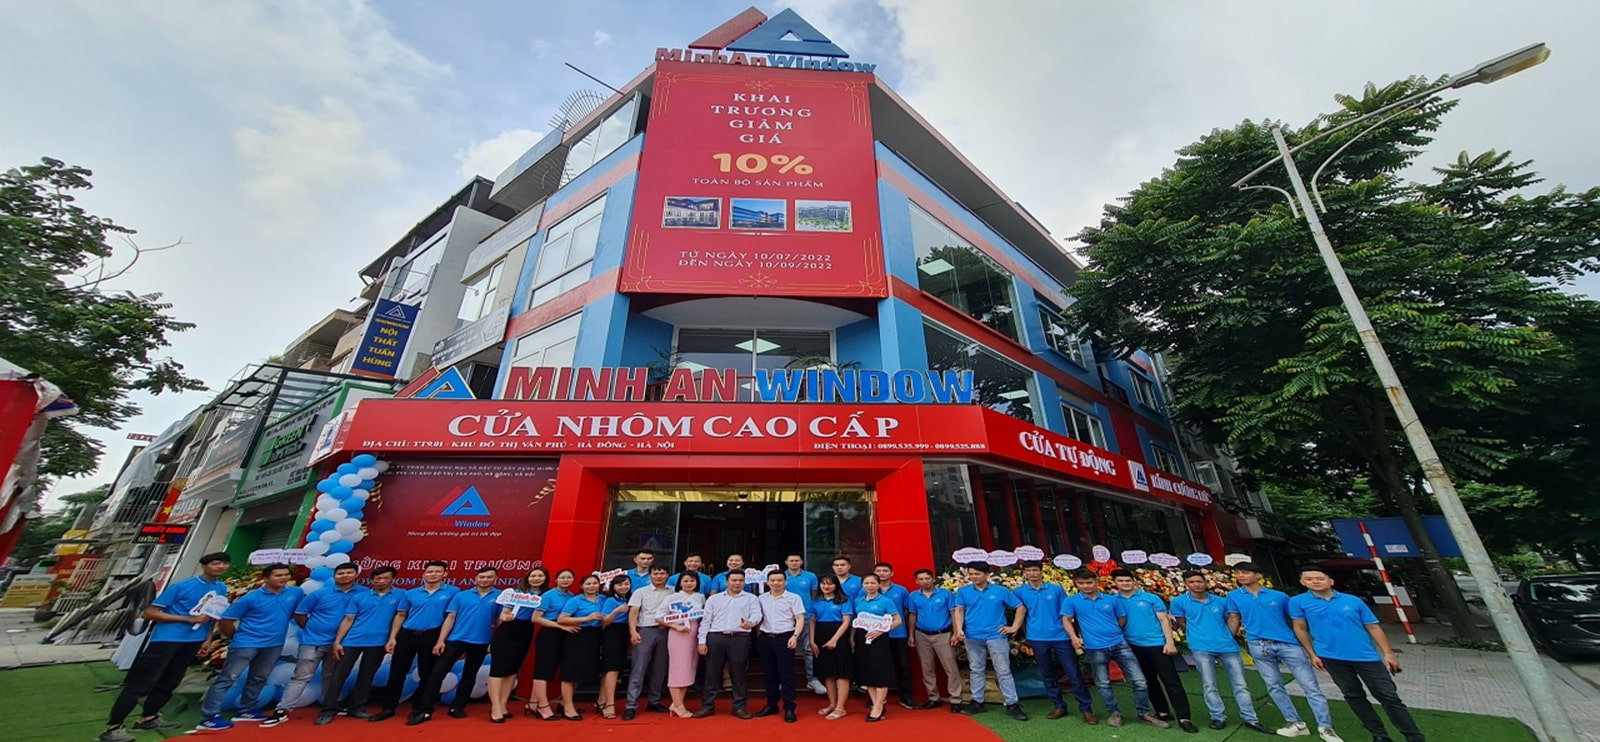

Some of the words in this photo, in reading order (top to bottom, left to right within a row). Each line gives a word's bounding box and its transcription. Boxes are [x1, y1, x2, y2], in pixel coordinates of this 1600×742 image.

[733, 93, 791, 103] KHAI
[711, 105, 812, 117] TRƯƠNG
[729, 118, 793, 130] GIẢM
[739, 133, 782, 144] GIÁ
[713, 152, 813, 175] 10%
[692, 177, 729, 186] TOÀN
[734, 178, 751, 187] BỘ
[756, 178, 781, 187] SẢN
[786, 179, 824, 189] PHẨM
[705, 250, 747, 260] NGÀY
[754, 252, 831, 262] 10/07/2022
[713, 259, 753, 268] NGÀY
[760, 261, 832, 270] 10/09/2022
[380, 327, 398, 337] NỘI
[373, 335, 398, 347] THẤT
[368, 346, 395, 358] TUẤN
[504, 367, 650, 401] MINH
[663, 367, 737, 401] AN
[755, 369, 975, 403] WINDOW
[448, 408, 539, 438] CỬA
[556, 411, 697, 438] NHÔM
[703, 415, 797, 438] CAO
[809, 410, 899, 438] CẤP
[362, 440, 382, 449] ĐỊA
[479, 440, 496, 448] ĐÔ
[500, 441, 518, 449] THỊ
[577, 440, 592, 449] HÀ
[597, 441, 626, 449] ĐÔNG
[636, 441, 652, 449] HÀ
[656, 441, 675, 450] NỘI
[814, 442, 838, 450] ĐIỆN
[1019, 430, 1057, 459] CỬA
[1056, 442, 1078, 469] TỰ
[1079, 449, 1117, 476] ĐỘNG
